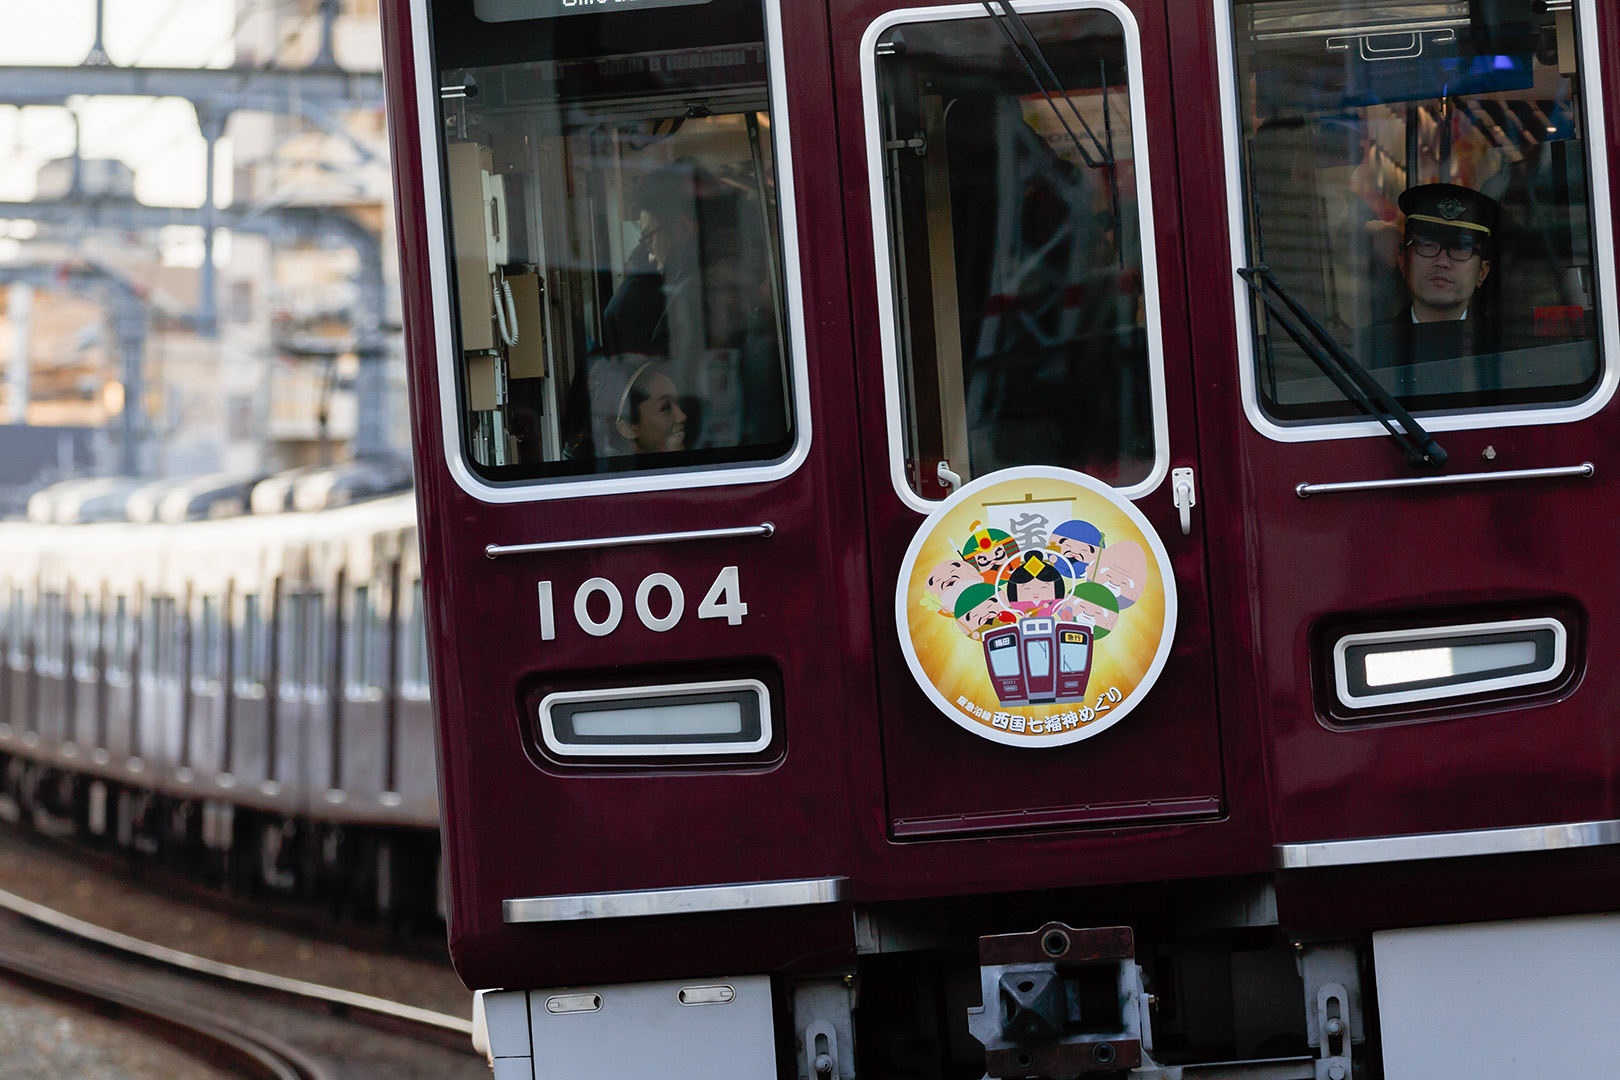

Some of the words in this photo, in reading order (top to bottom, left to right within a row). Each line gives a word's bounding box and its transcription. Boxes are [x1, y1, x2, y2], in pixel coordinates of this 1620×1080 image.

[1009, 513, 1049, 551] 宝
[538, 566, 748, 641] 1004
[994, 637, 1010, 648] 梅田
[1066, 633, 1082, 642] 急行
[956, 695, 992, 722] 阪急沿線
[992, 686, 1122, 733] 西国七福神めぐり
